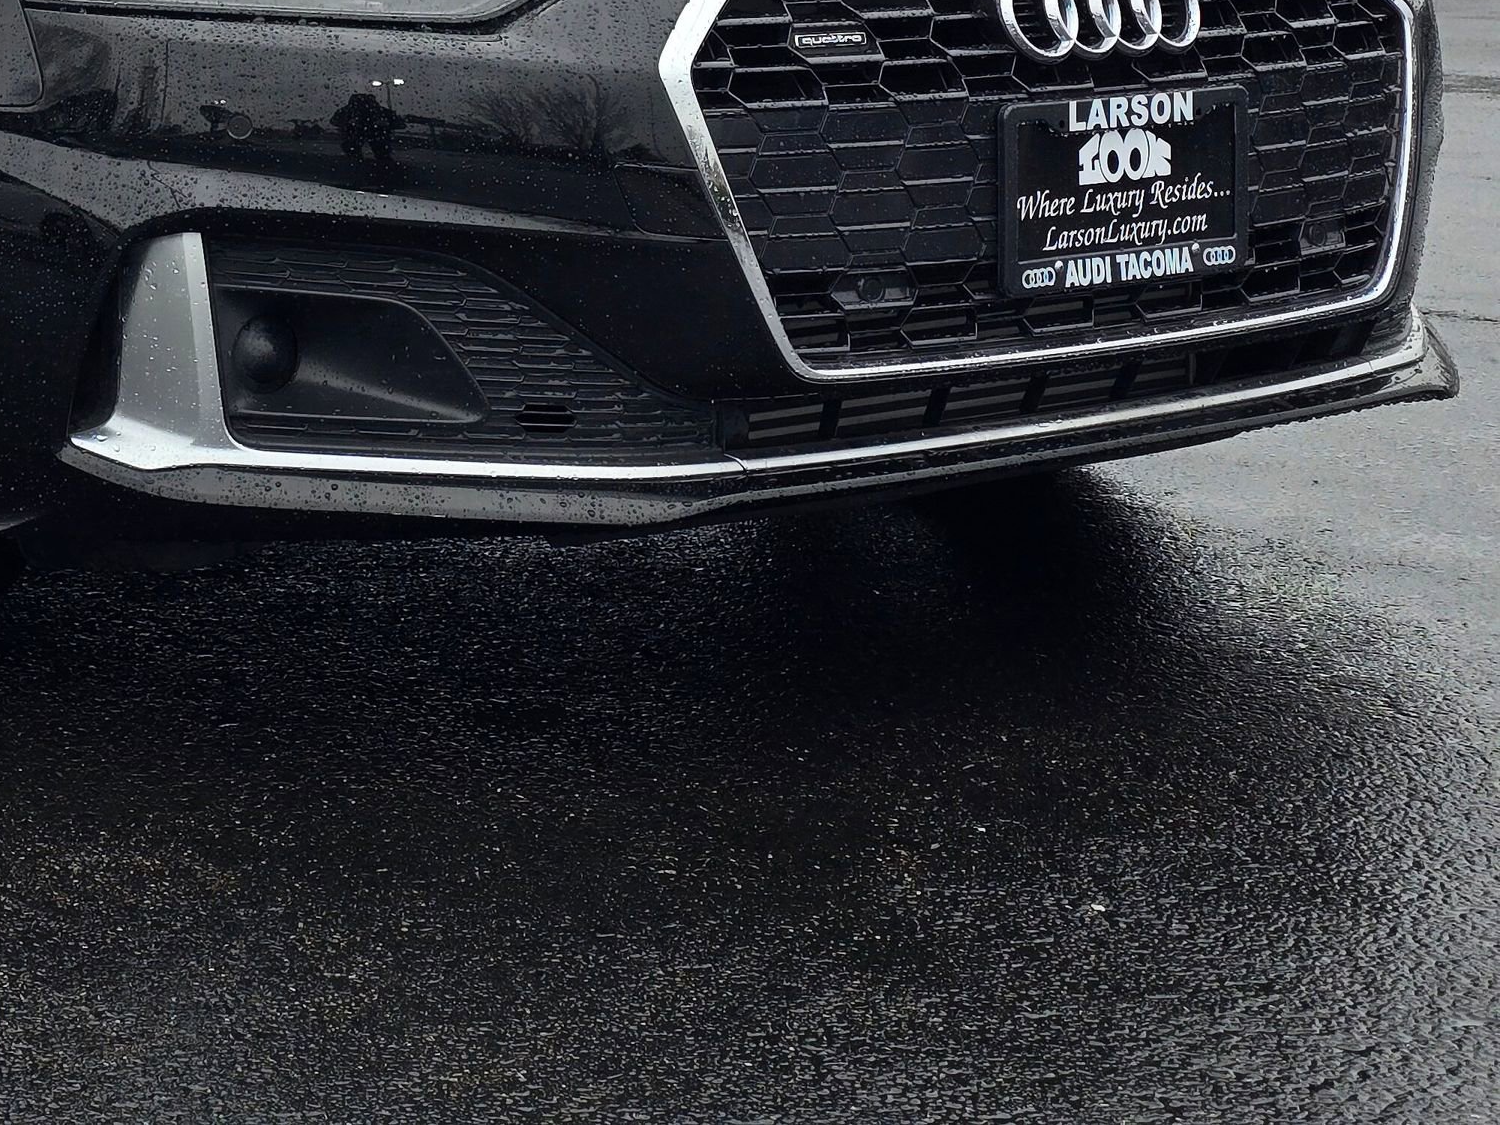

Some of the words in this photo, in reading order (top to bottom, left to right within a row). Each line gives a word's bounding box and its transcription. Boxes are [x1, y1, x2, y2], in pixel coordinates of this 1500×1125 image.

[801, 34, 863, 46] quattro
[1068, 90, 1194, 132] LARSON
[1016, 189, 1076, 221] Where
[1080, 188, 1145, 217] Luxury
[1149, 172, 1231, 209] Resides...
[1042, 212, 1209, 251] LarsonLuxury.com
[1064, 256, 1112, 288] AUDI
[1116, 246, 1194, 282] TACOMA
